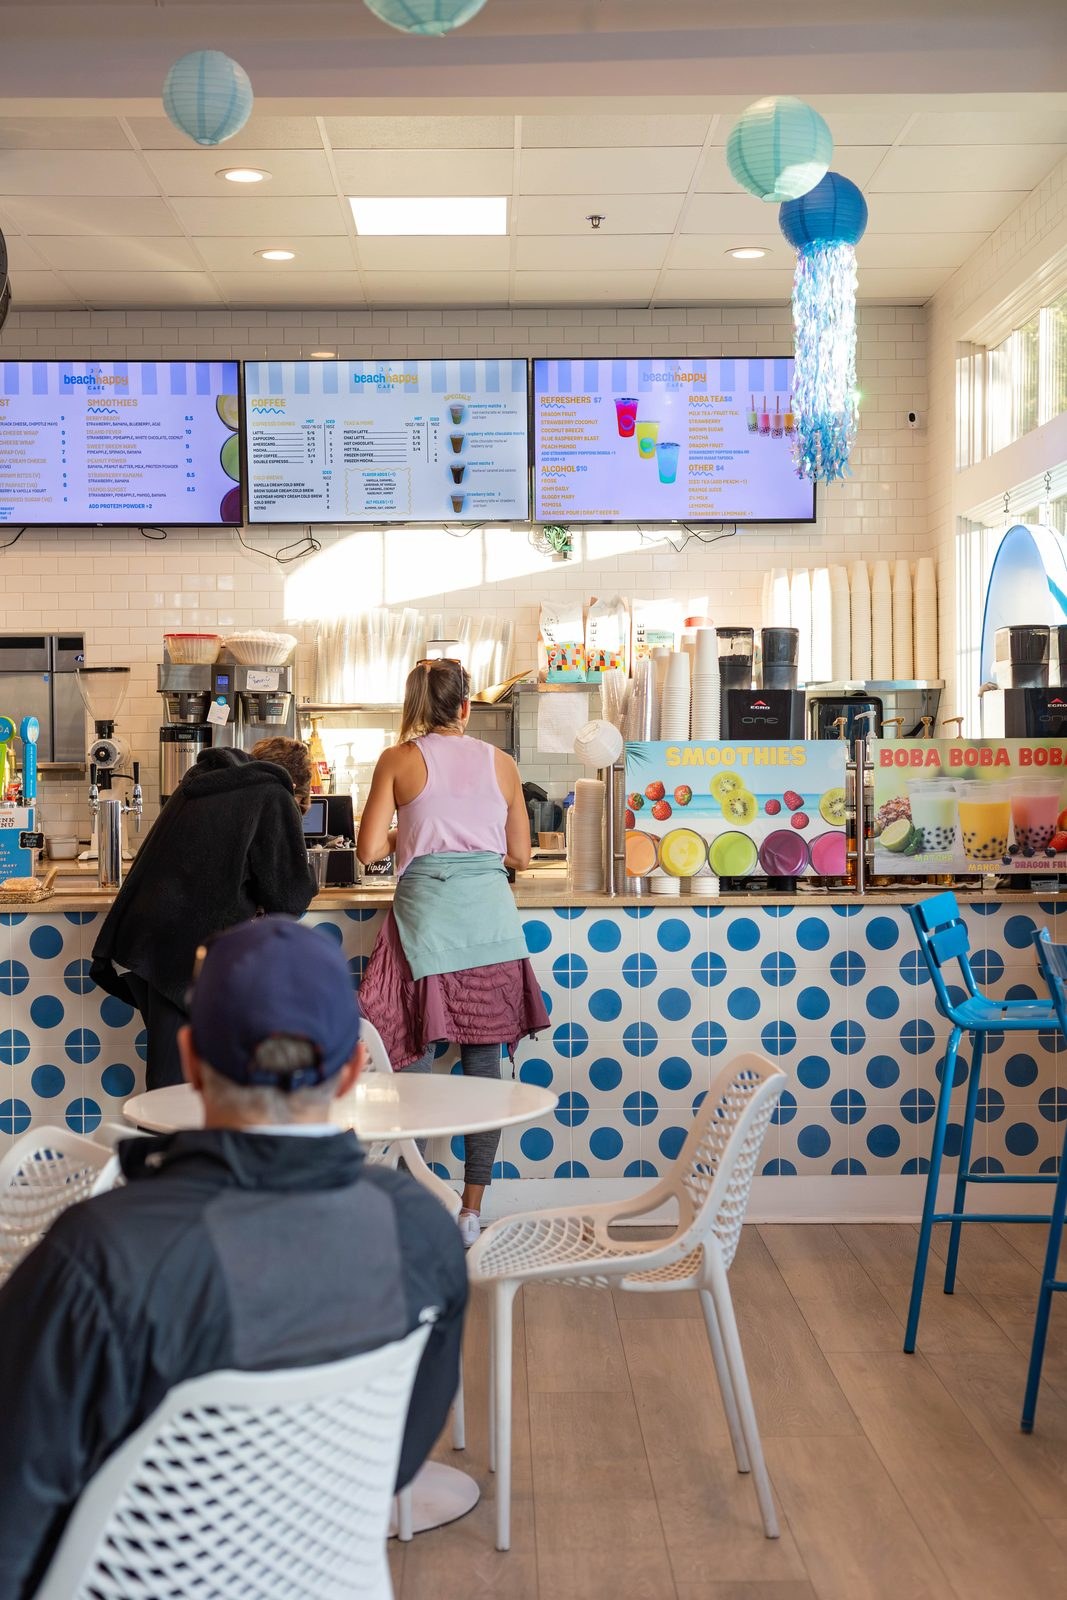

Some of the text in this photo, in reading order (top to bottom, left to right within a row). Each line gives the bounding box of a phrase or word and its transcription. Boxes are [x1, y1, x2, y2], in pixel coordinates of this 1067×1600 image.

[354, 373, 418, 384] beachhappy
[643, 372, 706, 383] beachhappy
[666, 746, 807, 767] SMOOTHIES
[880, 747, 1067, 767] BOBA BOBA BOB
[914, 854, 953, 862] MATCHA
[368, 862, 391, 873] Tipsy?
[1014, 861, 1052, 869] DRAGON
